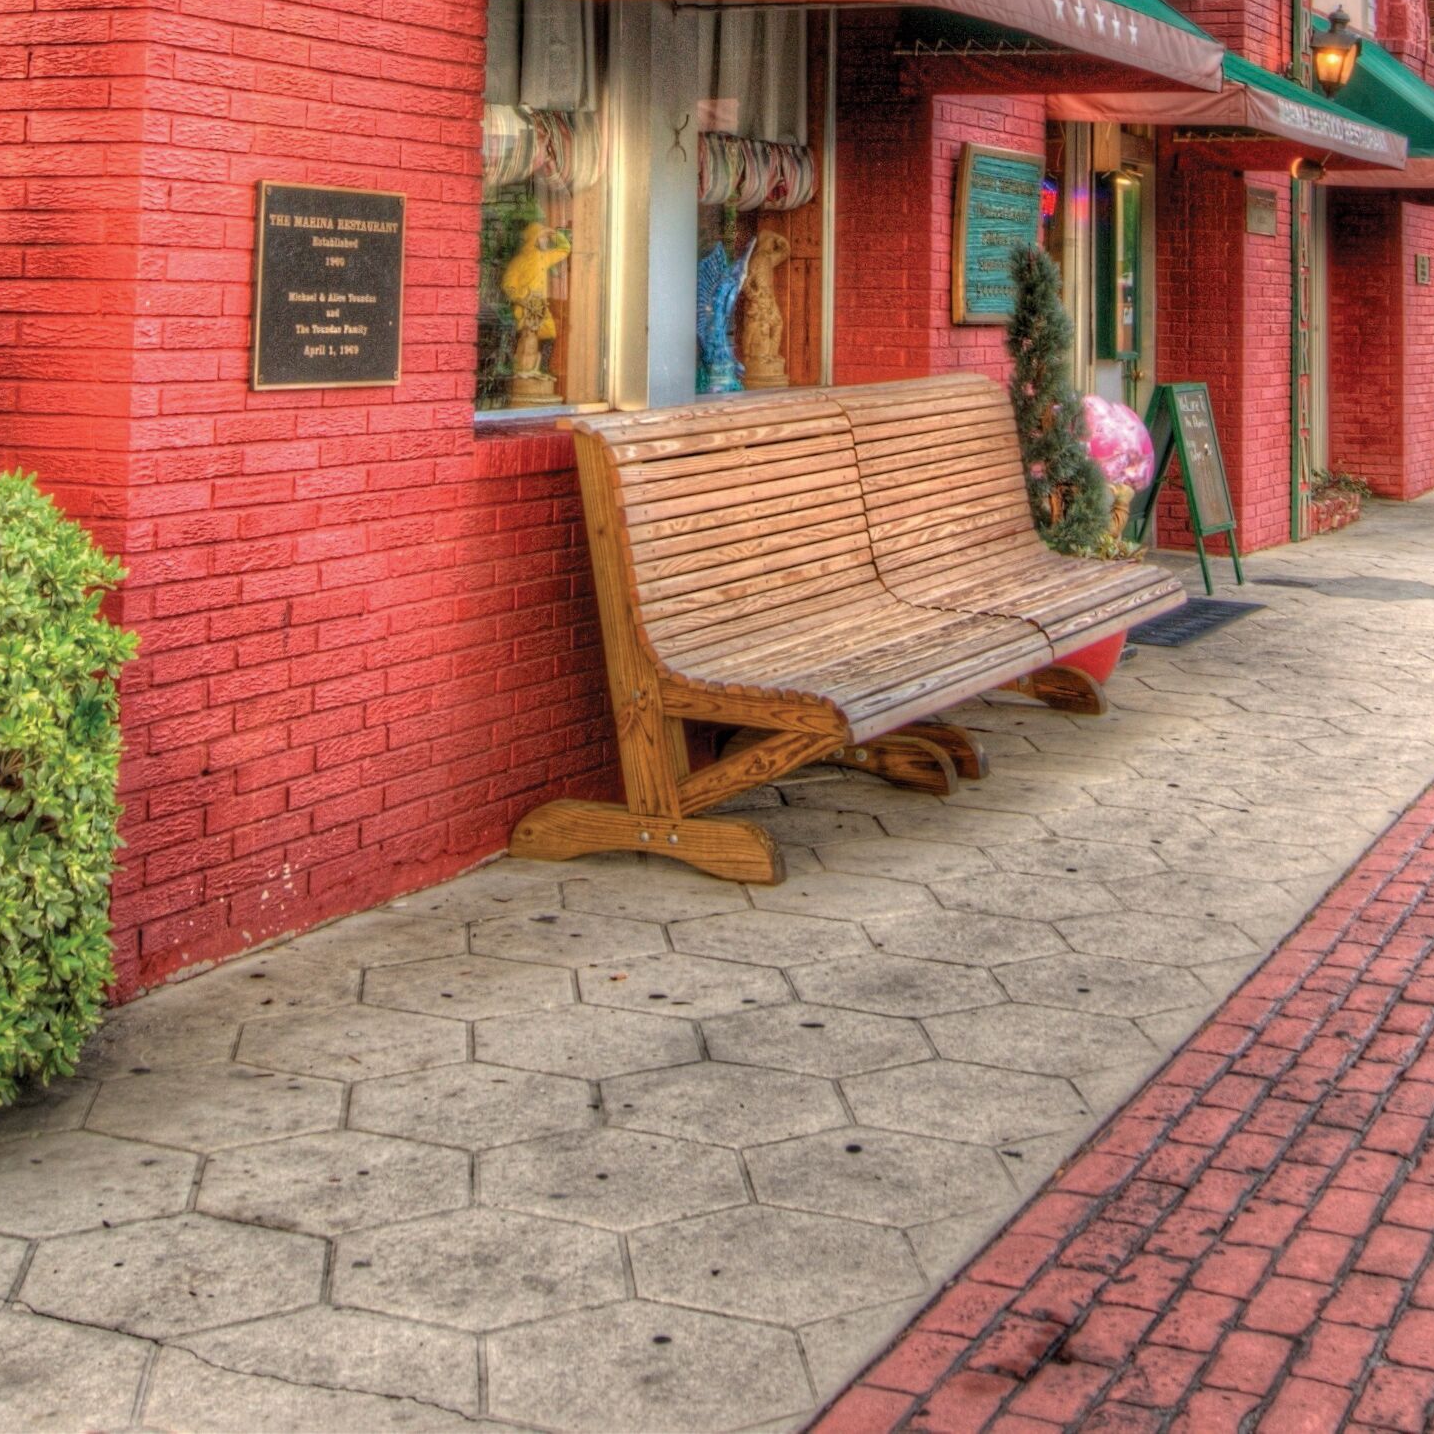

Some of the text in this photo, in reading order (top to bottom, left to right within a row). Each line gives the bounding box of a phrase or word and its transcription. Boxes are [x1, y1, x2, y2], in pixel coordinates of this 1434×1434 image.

[269, 213, 399, 233] THE MARINA RESTAURANT
[312, 236, 359, 249] Established
[288, 292, 317, 303] Michael
[319, 293, 326, 303] &
[326, 308, 340, 318] and
[295, 324, 310, 335] The
[343, 324, 368, 336] Family
[303, 344, 326, 358] April
[329, 345, 337, 356] 1,
